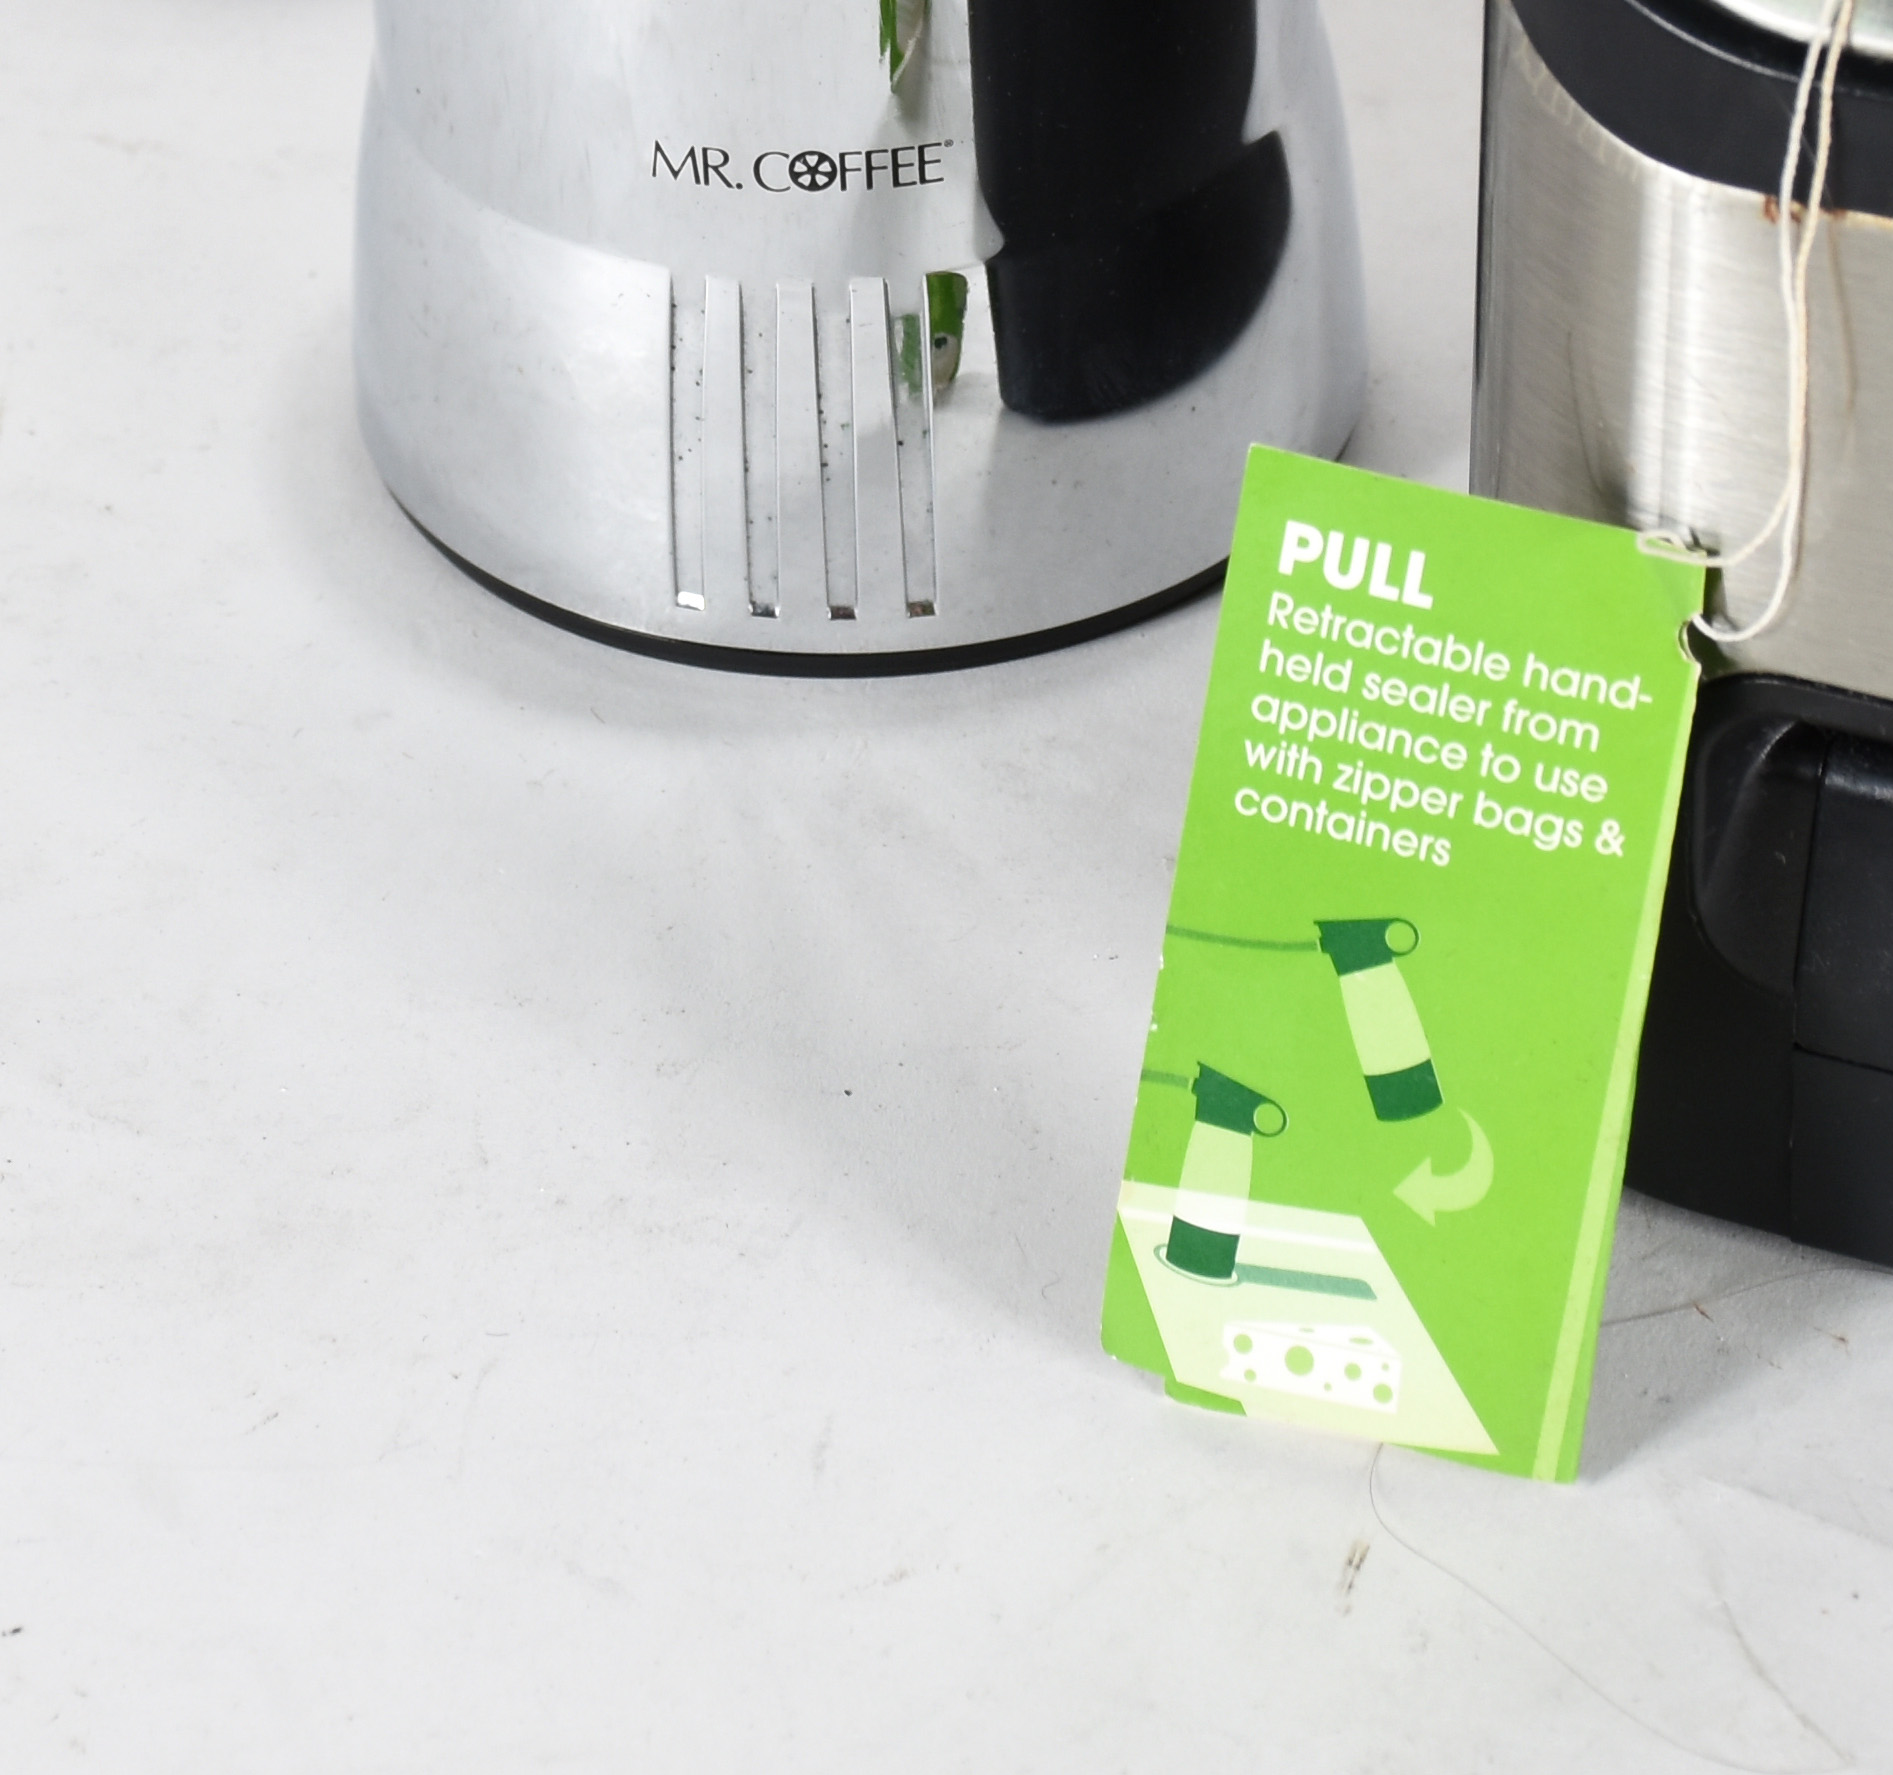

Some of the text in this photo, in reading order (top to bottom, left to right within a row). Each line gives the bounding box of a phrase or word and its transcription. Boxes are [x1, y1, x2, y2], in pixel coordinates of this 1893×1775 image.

[651, 138, 744, 190] MR.
[1277, 519, 1434, 610] PULL
[1258, 638, 1600, 752] held sealer from
[1267, 590, 1653, 711] Retractable hand-
[1244, 738, 1626, 858] with zipper bags &
[1250, 692, 1609, 804] appliance to use
[1234, 786, 1452, 867] containers
